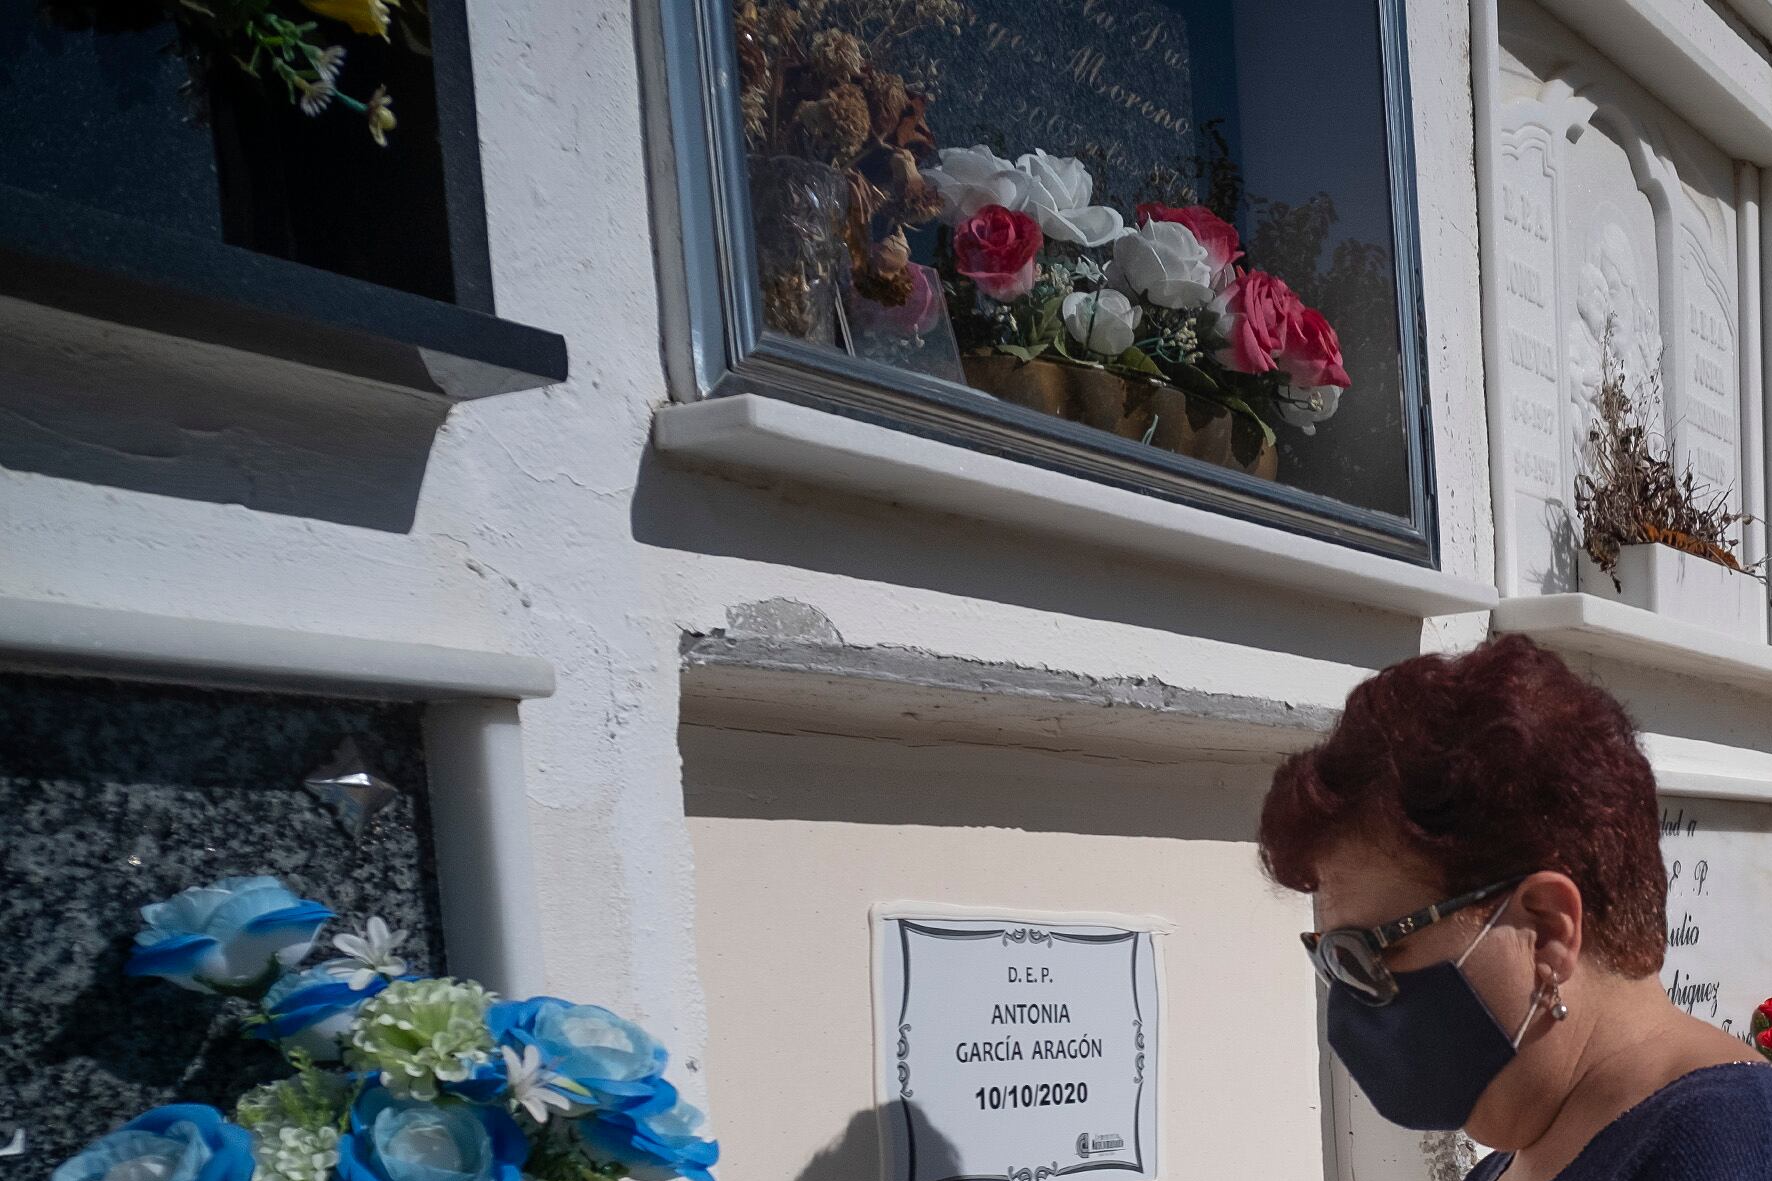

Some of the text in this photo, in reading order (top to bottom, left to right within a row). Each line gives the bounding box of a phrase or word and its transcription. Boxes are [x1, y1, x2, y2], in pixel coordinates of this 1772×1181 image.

[1060, 45, 1192, 136] Moreno
[1667, 911, 1700, 948] ulio
[1664, 969, 1720, 1017] driguez
[991, 1003, 1071, 1025] ANTONIA
[956, 1033, 1102, 1063] GARCÍA ARAGÓN
[975, 1081, 1088, 1110] 10/10/2020
